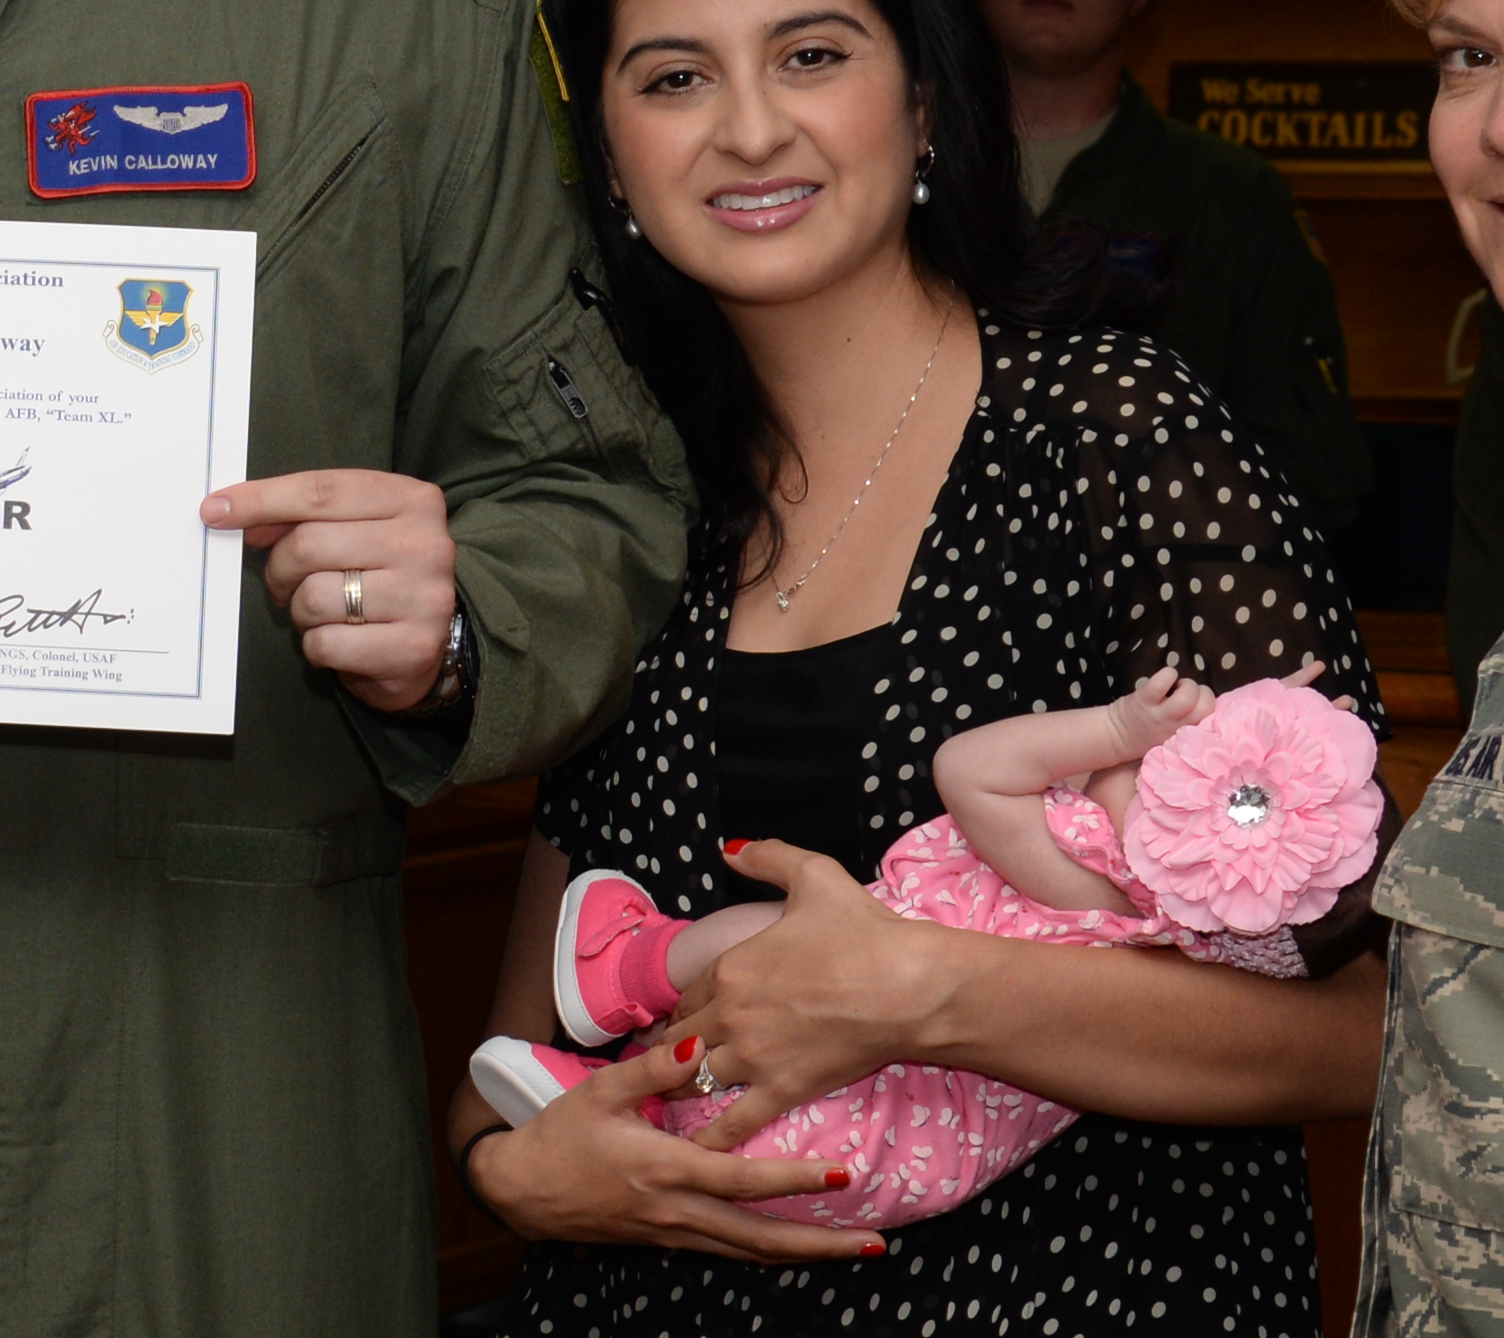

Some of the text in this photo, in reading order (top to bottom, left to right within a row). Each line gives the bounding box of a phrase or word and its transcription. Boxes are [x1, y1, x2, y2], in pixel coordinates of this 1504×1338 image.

[1200, 76, 1322, 106] We Serve
[1196, 108, 1420, 149] COCKTAILS
[69, 153, 218, 176] KEVIN CALLOWAY
[48, 390, 64, 402] of
[68, 394, 100, 406] your
[5, 407, 42, 422] AFB,
[46, 409, 93, 423] “Team
[32, 650, 79, 663] Colonel,
[83, 652, 117, 664] USAF
[1, 664, 37, 678] Flying
[40, 666, 89, 681] Training
[92, 669, 123, 682] Wing
[1465, 735, 1502, 781] AIR
